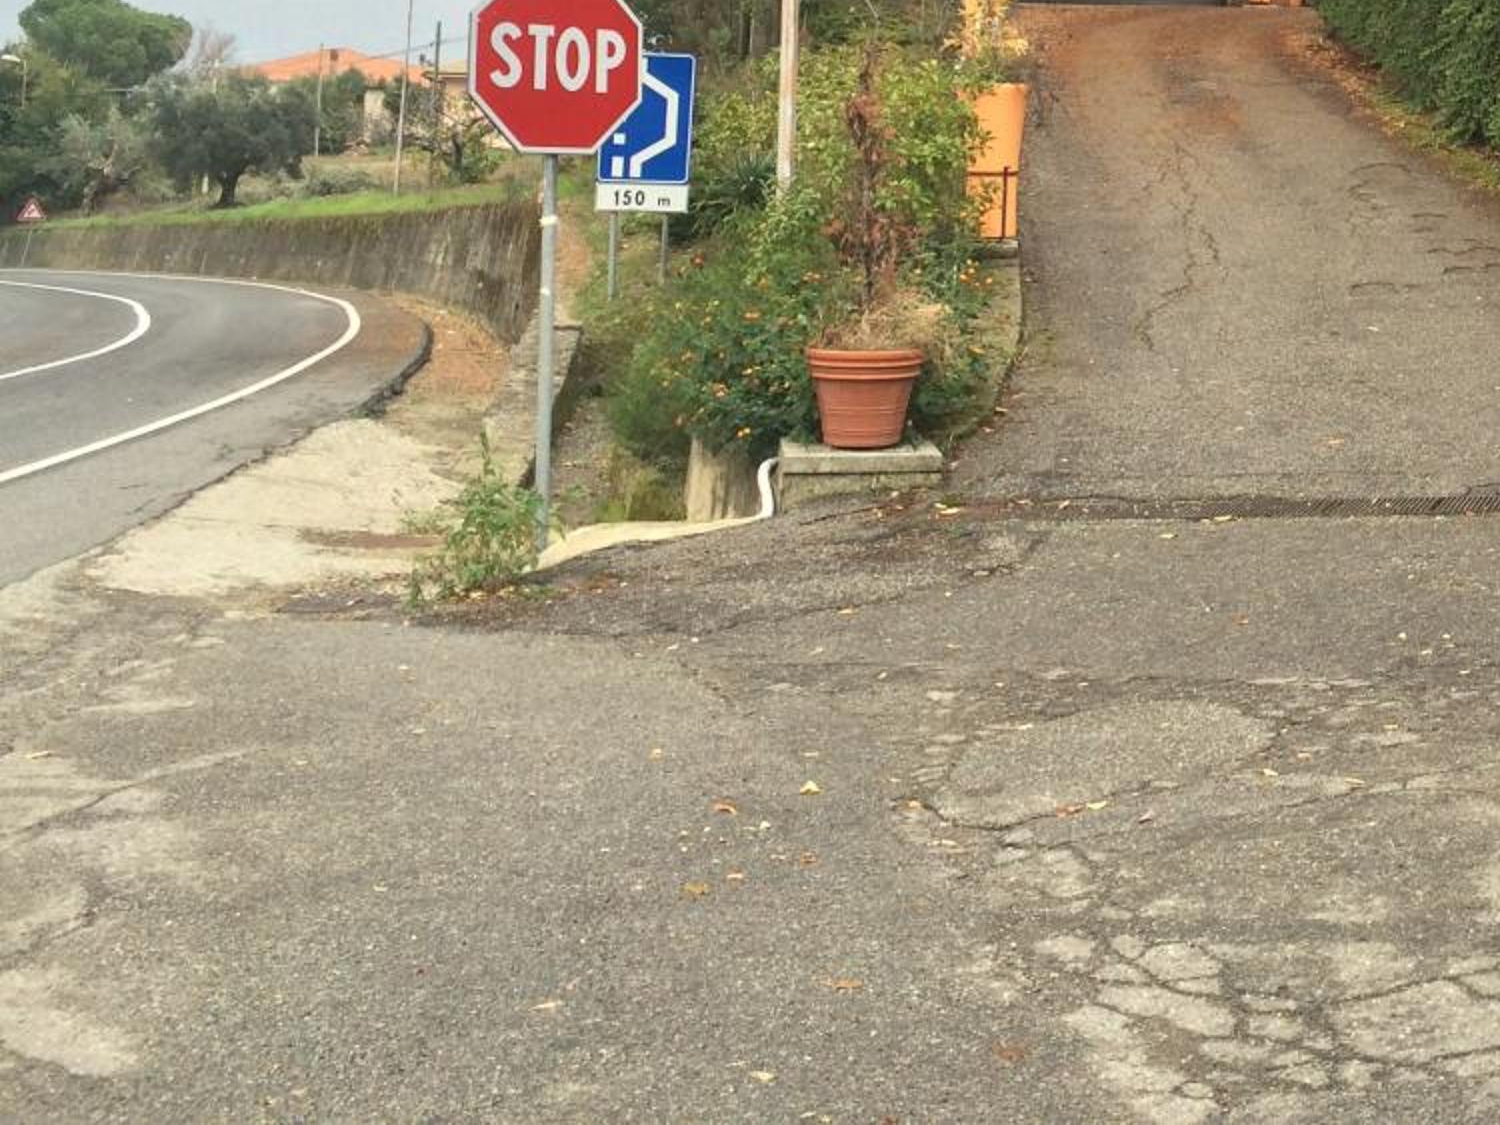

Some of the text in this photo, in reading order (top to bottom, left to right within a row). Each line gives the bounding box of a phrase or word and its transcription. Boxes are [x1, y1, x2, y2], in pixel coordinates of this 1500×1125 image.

[489, 21, 628, 94] STOP
[613, 190, 671, 207] 150 m
